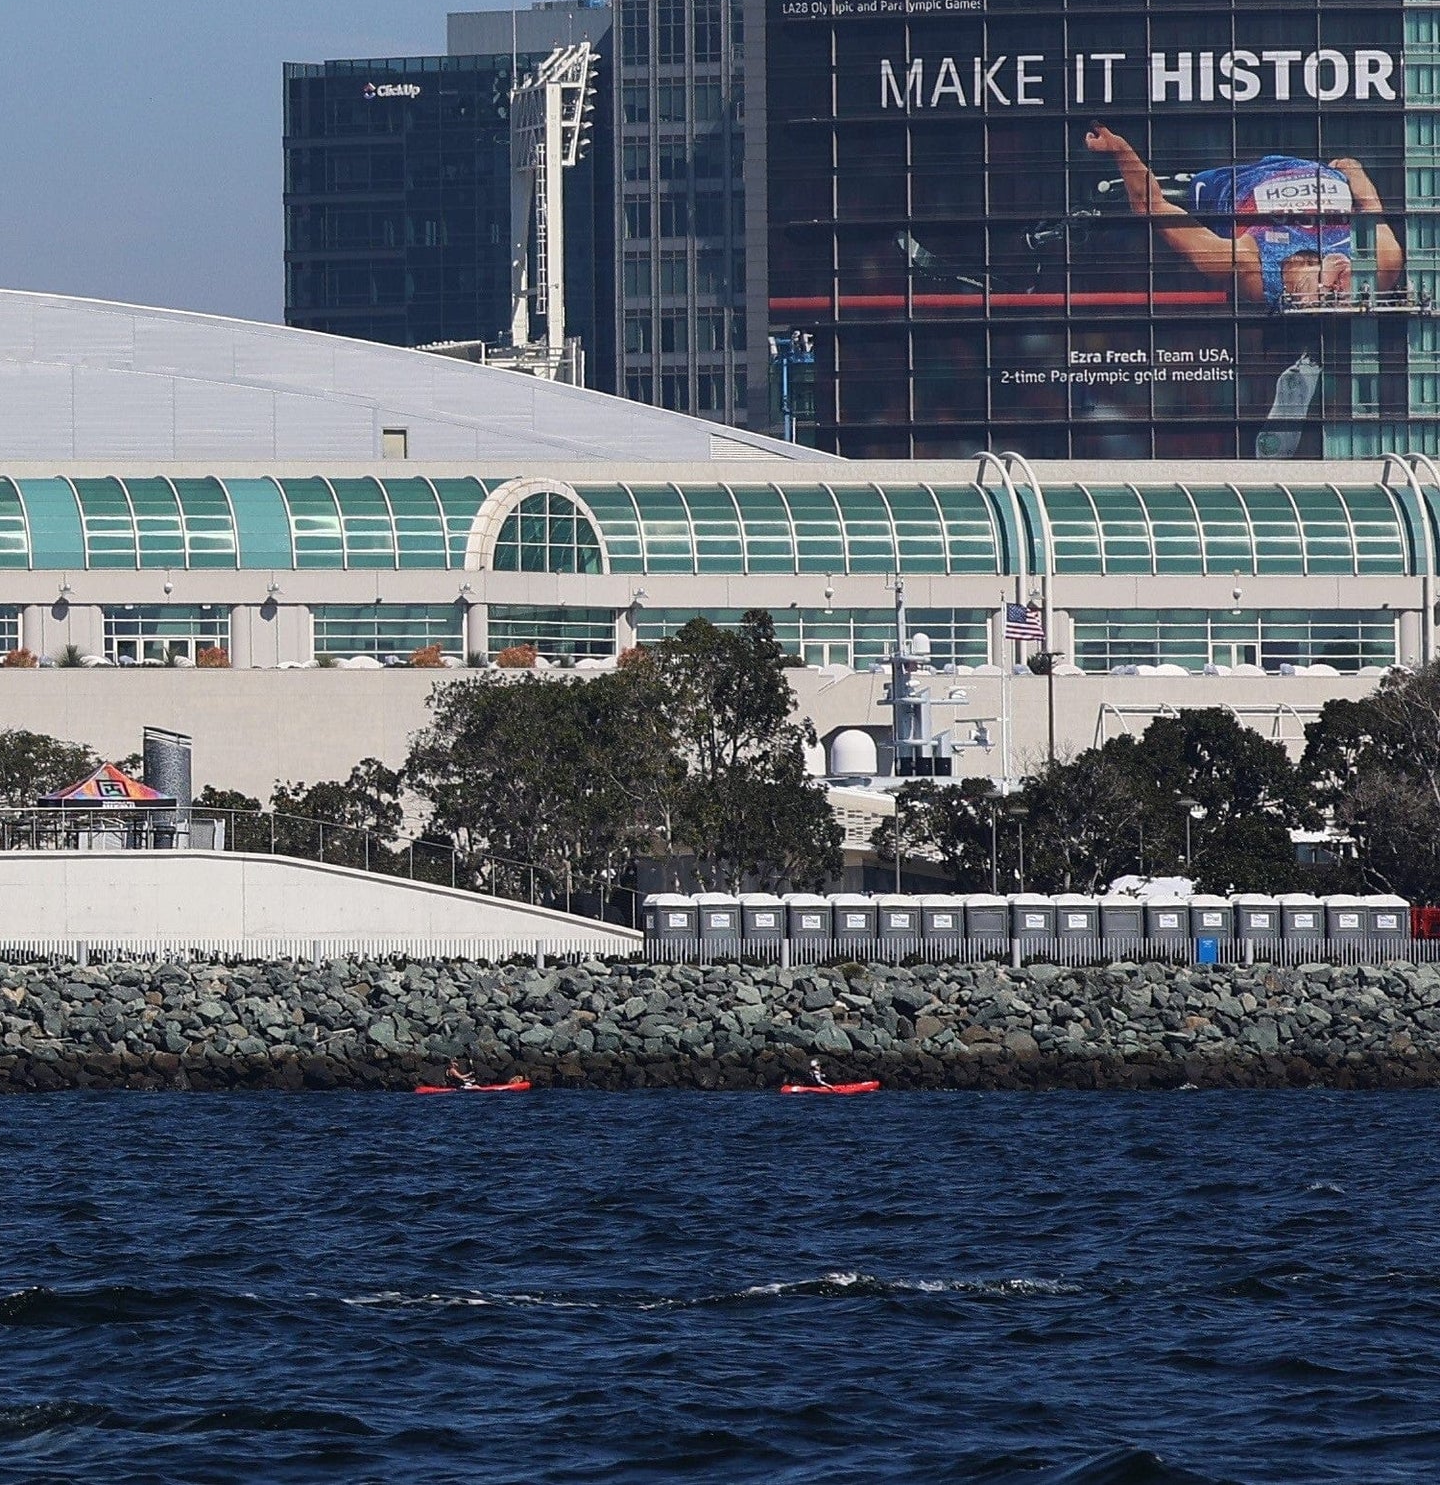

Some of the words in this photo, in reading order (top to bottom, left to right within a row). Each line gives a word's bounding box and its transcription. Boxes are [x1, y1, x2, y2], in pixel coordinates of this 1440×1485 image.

[782, 2, 808, 14] LA28
[857, 0, 877, 12] and
[881, 55, 1044, 108] MAKE
[1076, 53, 1126, 103] IT
[377, 83, 420, 99] ClickUp
[1070, 351, 1102, 364] Ezra
[1156, 349, 1194, 363] Team
[1199, 348, 1234, 364] USA,
[1000, 370, 1046, 384] 2-time
[1051, 369, 1130, 385] Paralympic
[1134, 368, 1167, 385] gold
[1172, 367, 1234, 381] medalist
